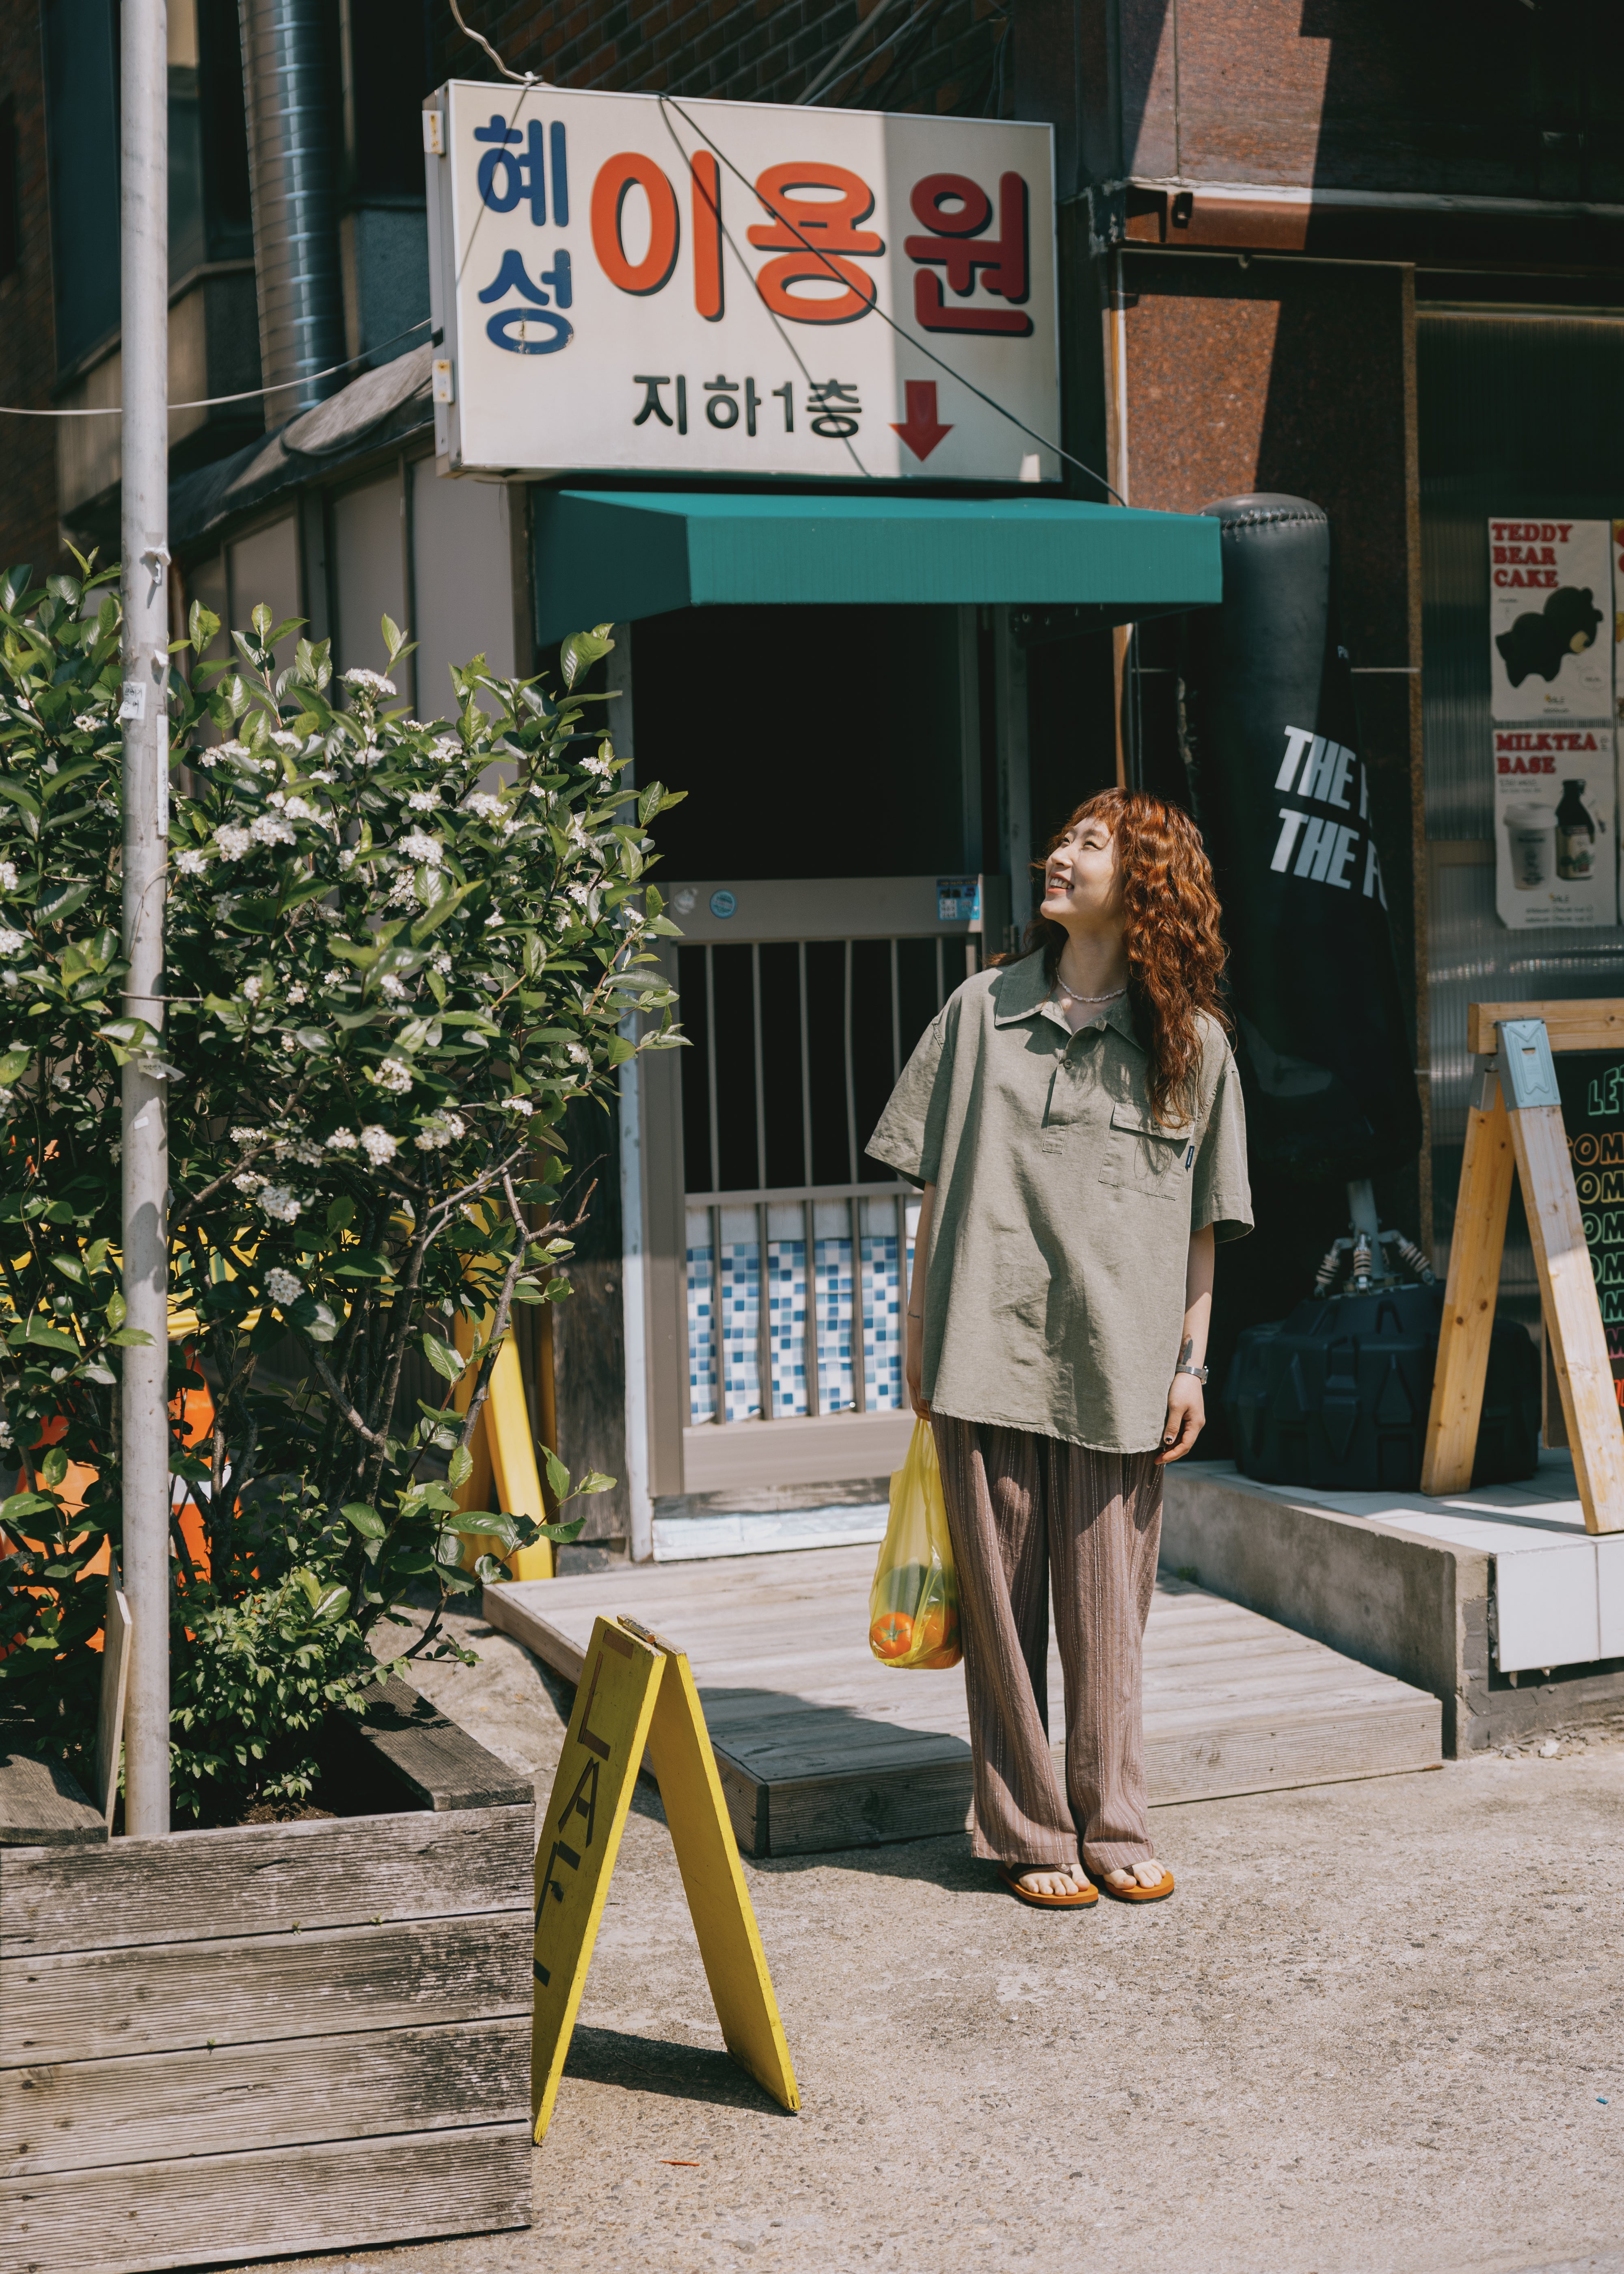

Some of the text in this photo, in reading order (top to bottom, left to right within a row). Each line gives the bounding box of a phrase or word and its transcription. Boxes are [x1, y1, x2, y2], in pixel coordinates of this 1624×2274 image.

[473, 114, 574, 355] 혜성
[591, 149, 1034, 337] 이용원
[633, 374, 862, 438] 지하1층
[1491, 522, 1573, 543] TEDDY
[1493, 546, 1557, 565] BEAR
[1494, 568, 1559, 587] CAKE
[1274, 725, 1356, 810] THE
[1496, 733, 1597, 750] MILKTEA
[1497, 756, 1556, 773] BASE
[1270, 808, 1360, 889] THE
[1588, 1064, 1624, 1116] LE
